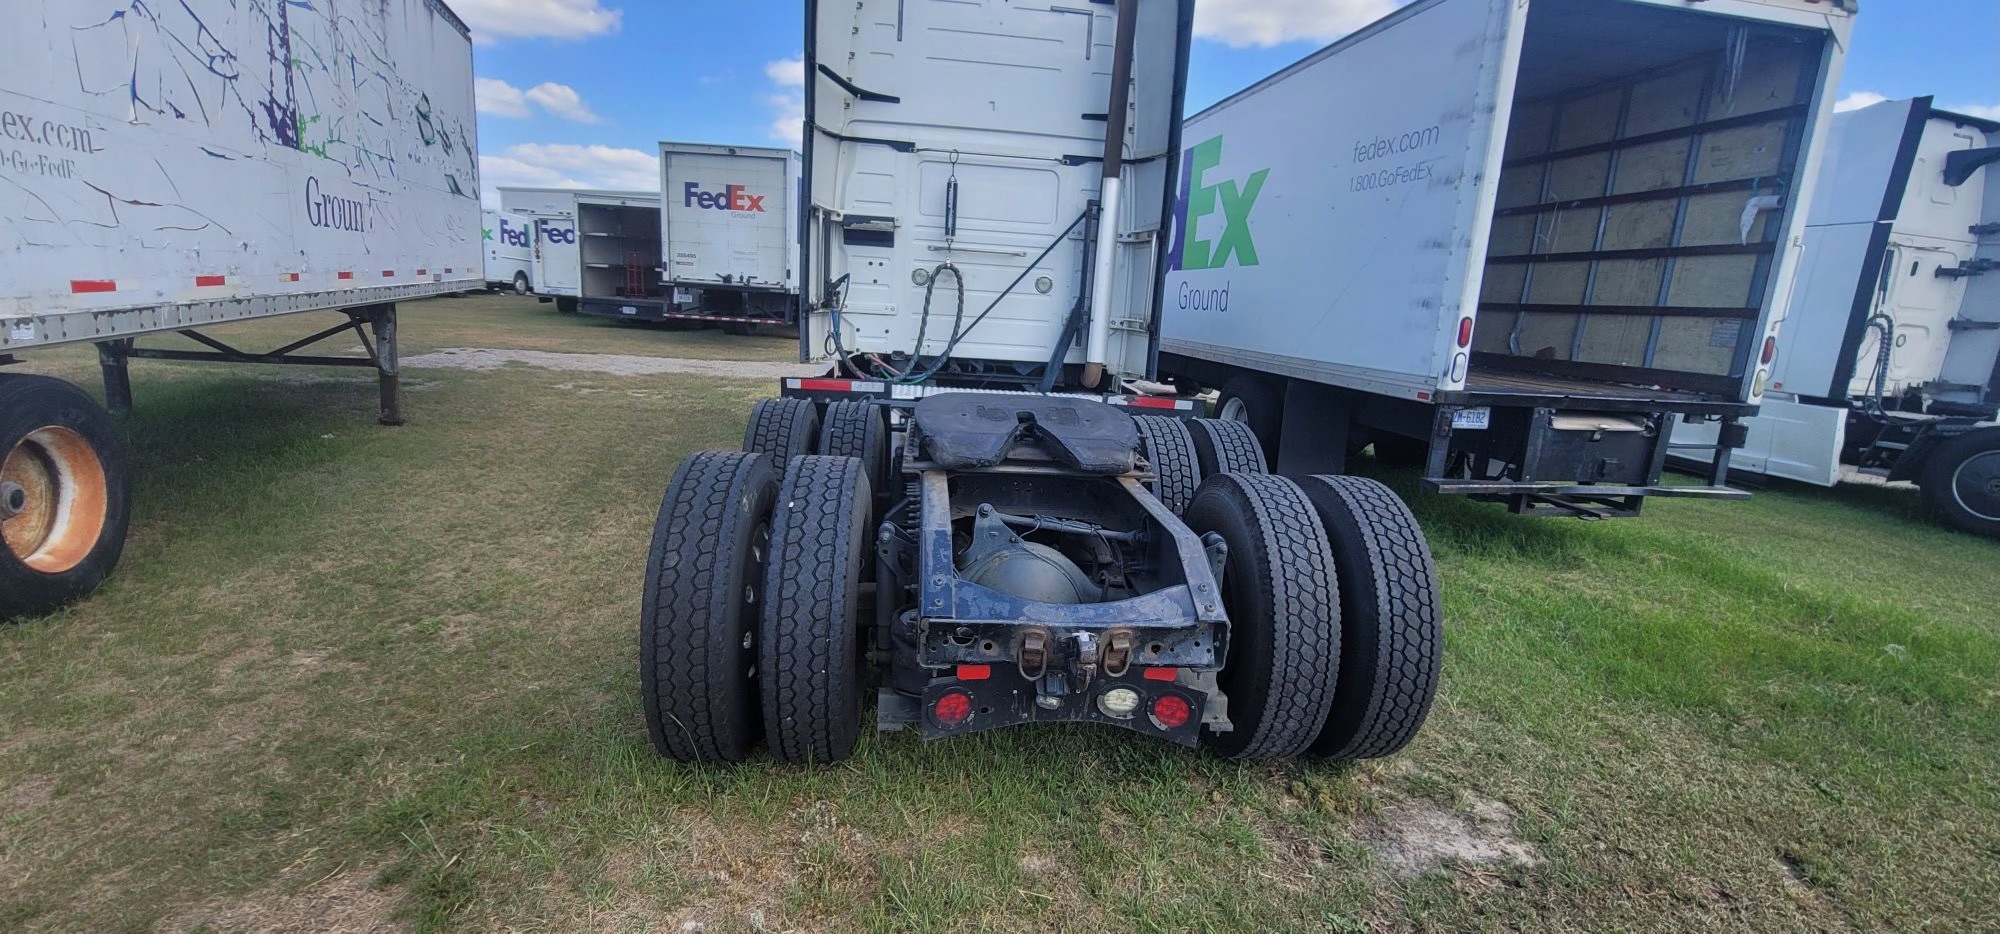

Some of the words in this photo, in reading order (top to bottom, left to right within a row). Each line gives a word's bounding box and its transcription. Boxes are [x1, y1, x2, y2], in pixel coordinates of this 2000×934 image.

[1353, 126, 1440, 164] fedex.com
[1350, 162, 1434, 193] 1.800.GoFedEx
[684, 181, 766, 213] FedEx
[1178, 280, 1230, 312] Ground
